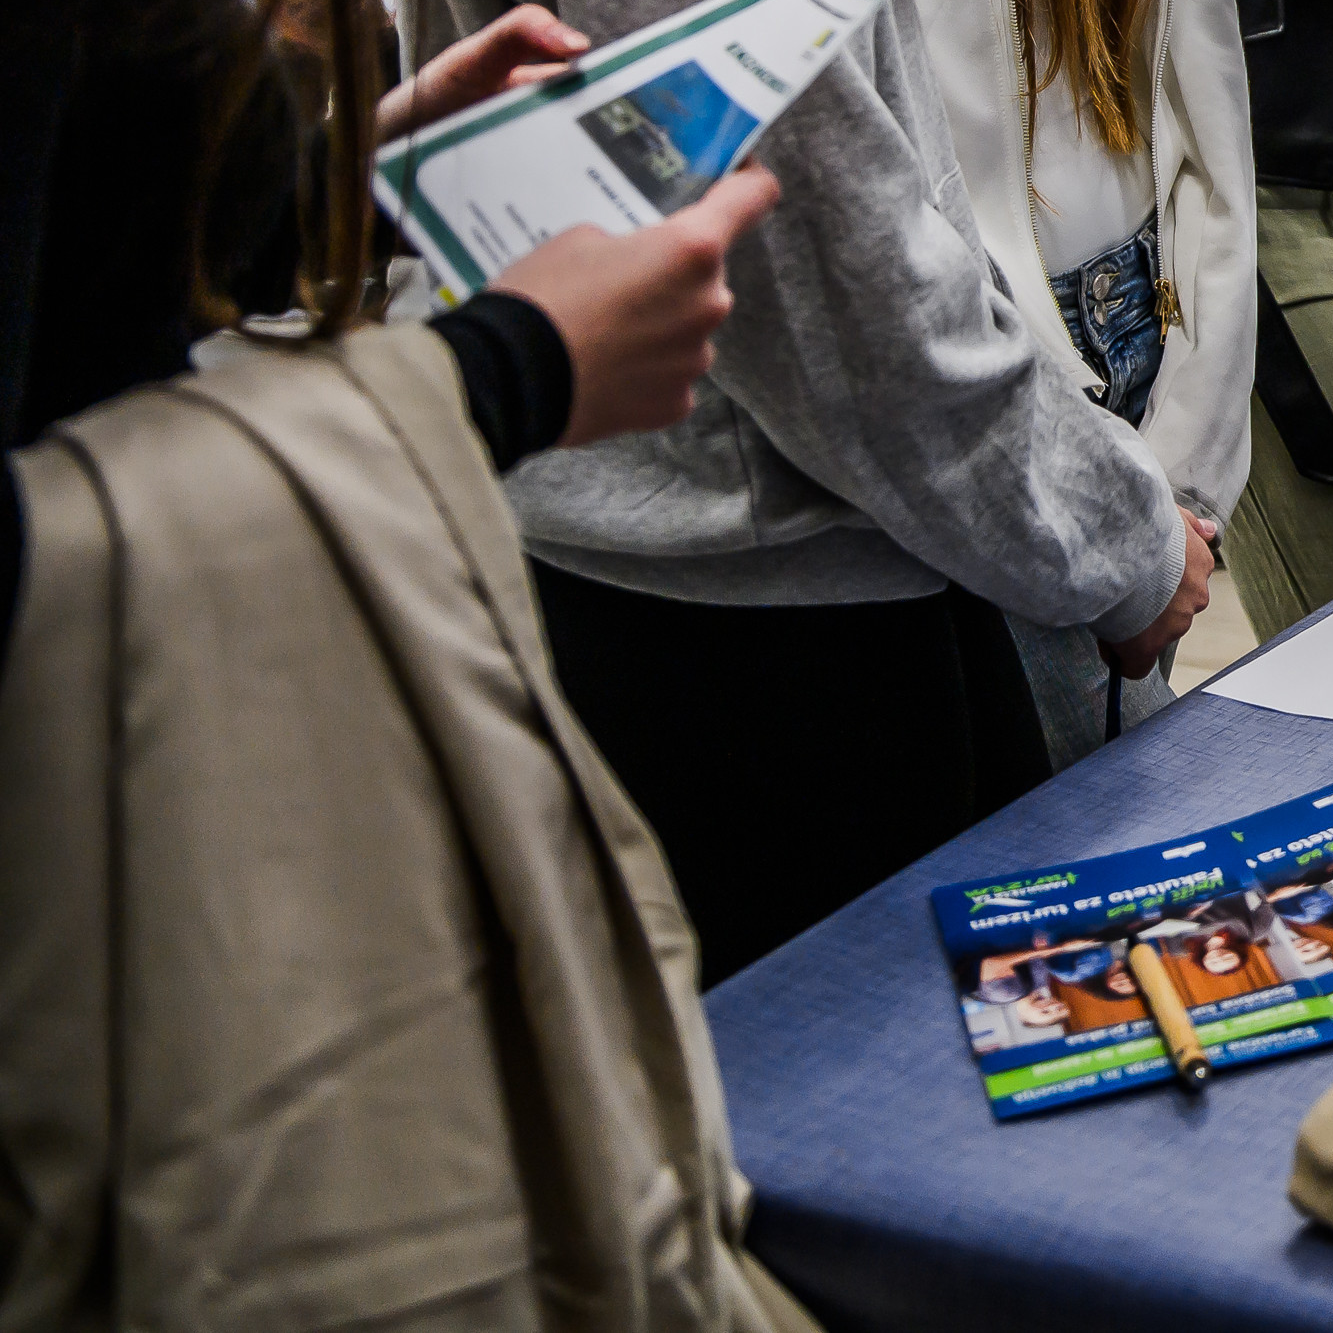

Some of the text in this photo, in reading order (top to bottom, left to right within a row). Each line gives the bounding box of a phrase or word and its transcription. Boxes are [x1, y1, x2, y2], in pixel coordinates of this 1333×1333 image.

[1256, 846, 1287, 864] za
[968, 865, 1223, 933] Fakulteto za turizem
